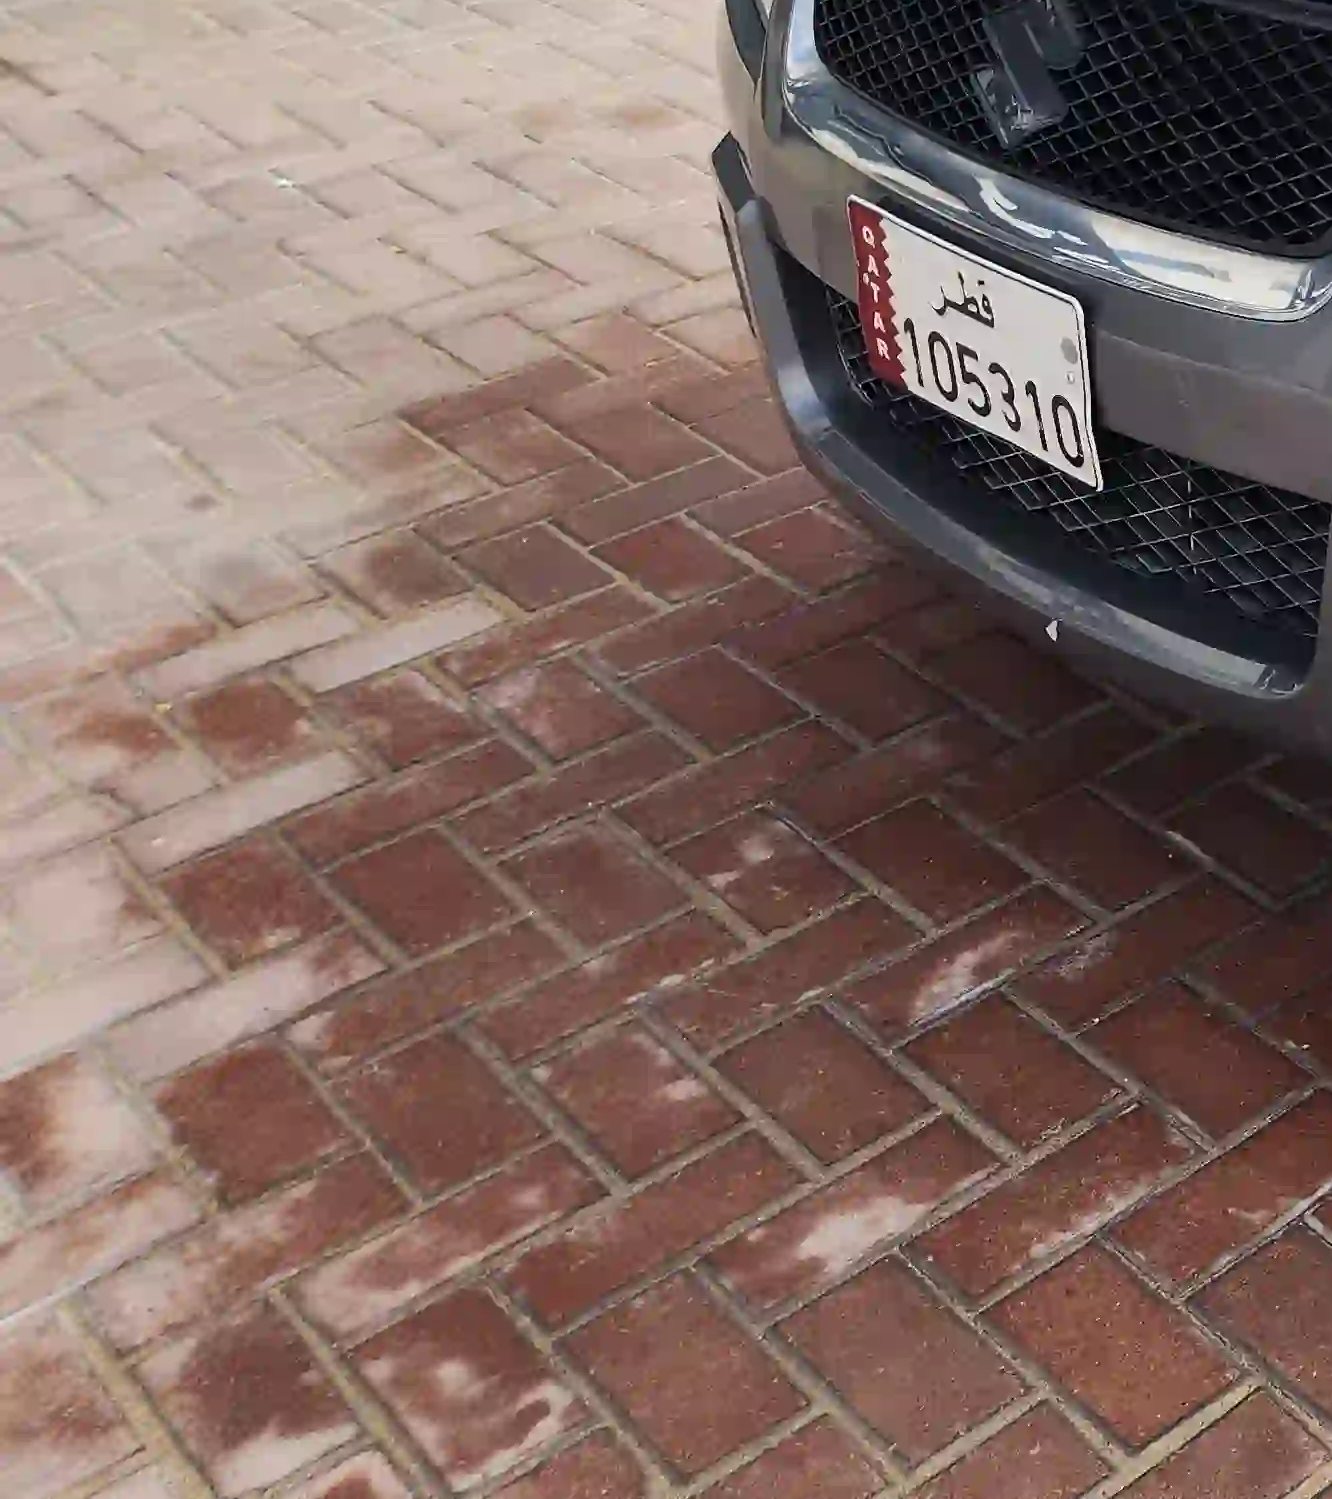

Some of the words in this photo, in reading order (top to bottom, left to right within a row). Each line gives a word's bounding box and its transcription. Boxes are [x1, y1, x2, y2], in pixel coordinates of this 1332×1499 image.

[861, 224, 891, 361] QATAR
[929, 270, 995, 329] قطر
[903, 317, 1085, 468] 105310
